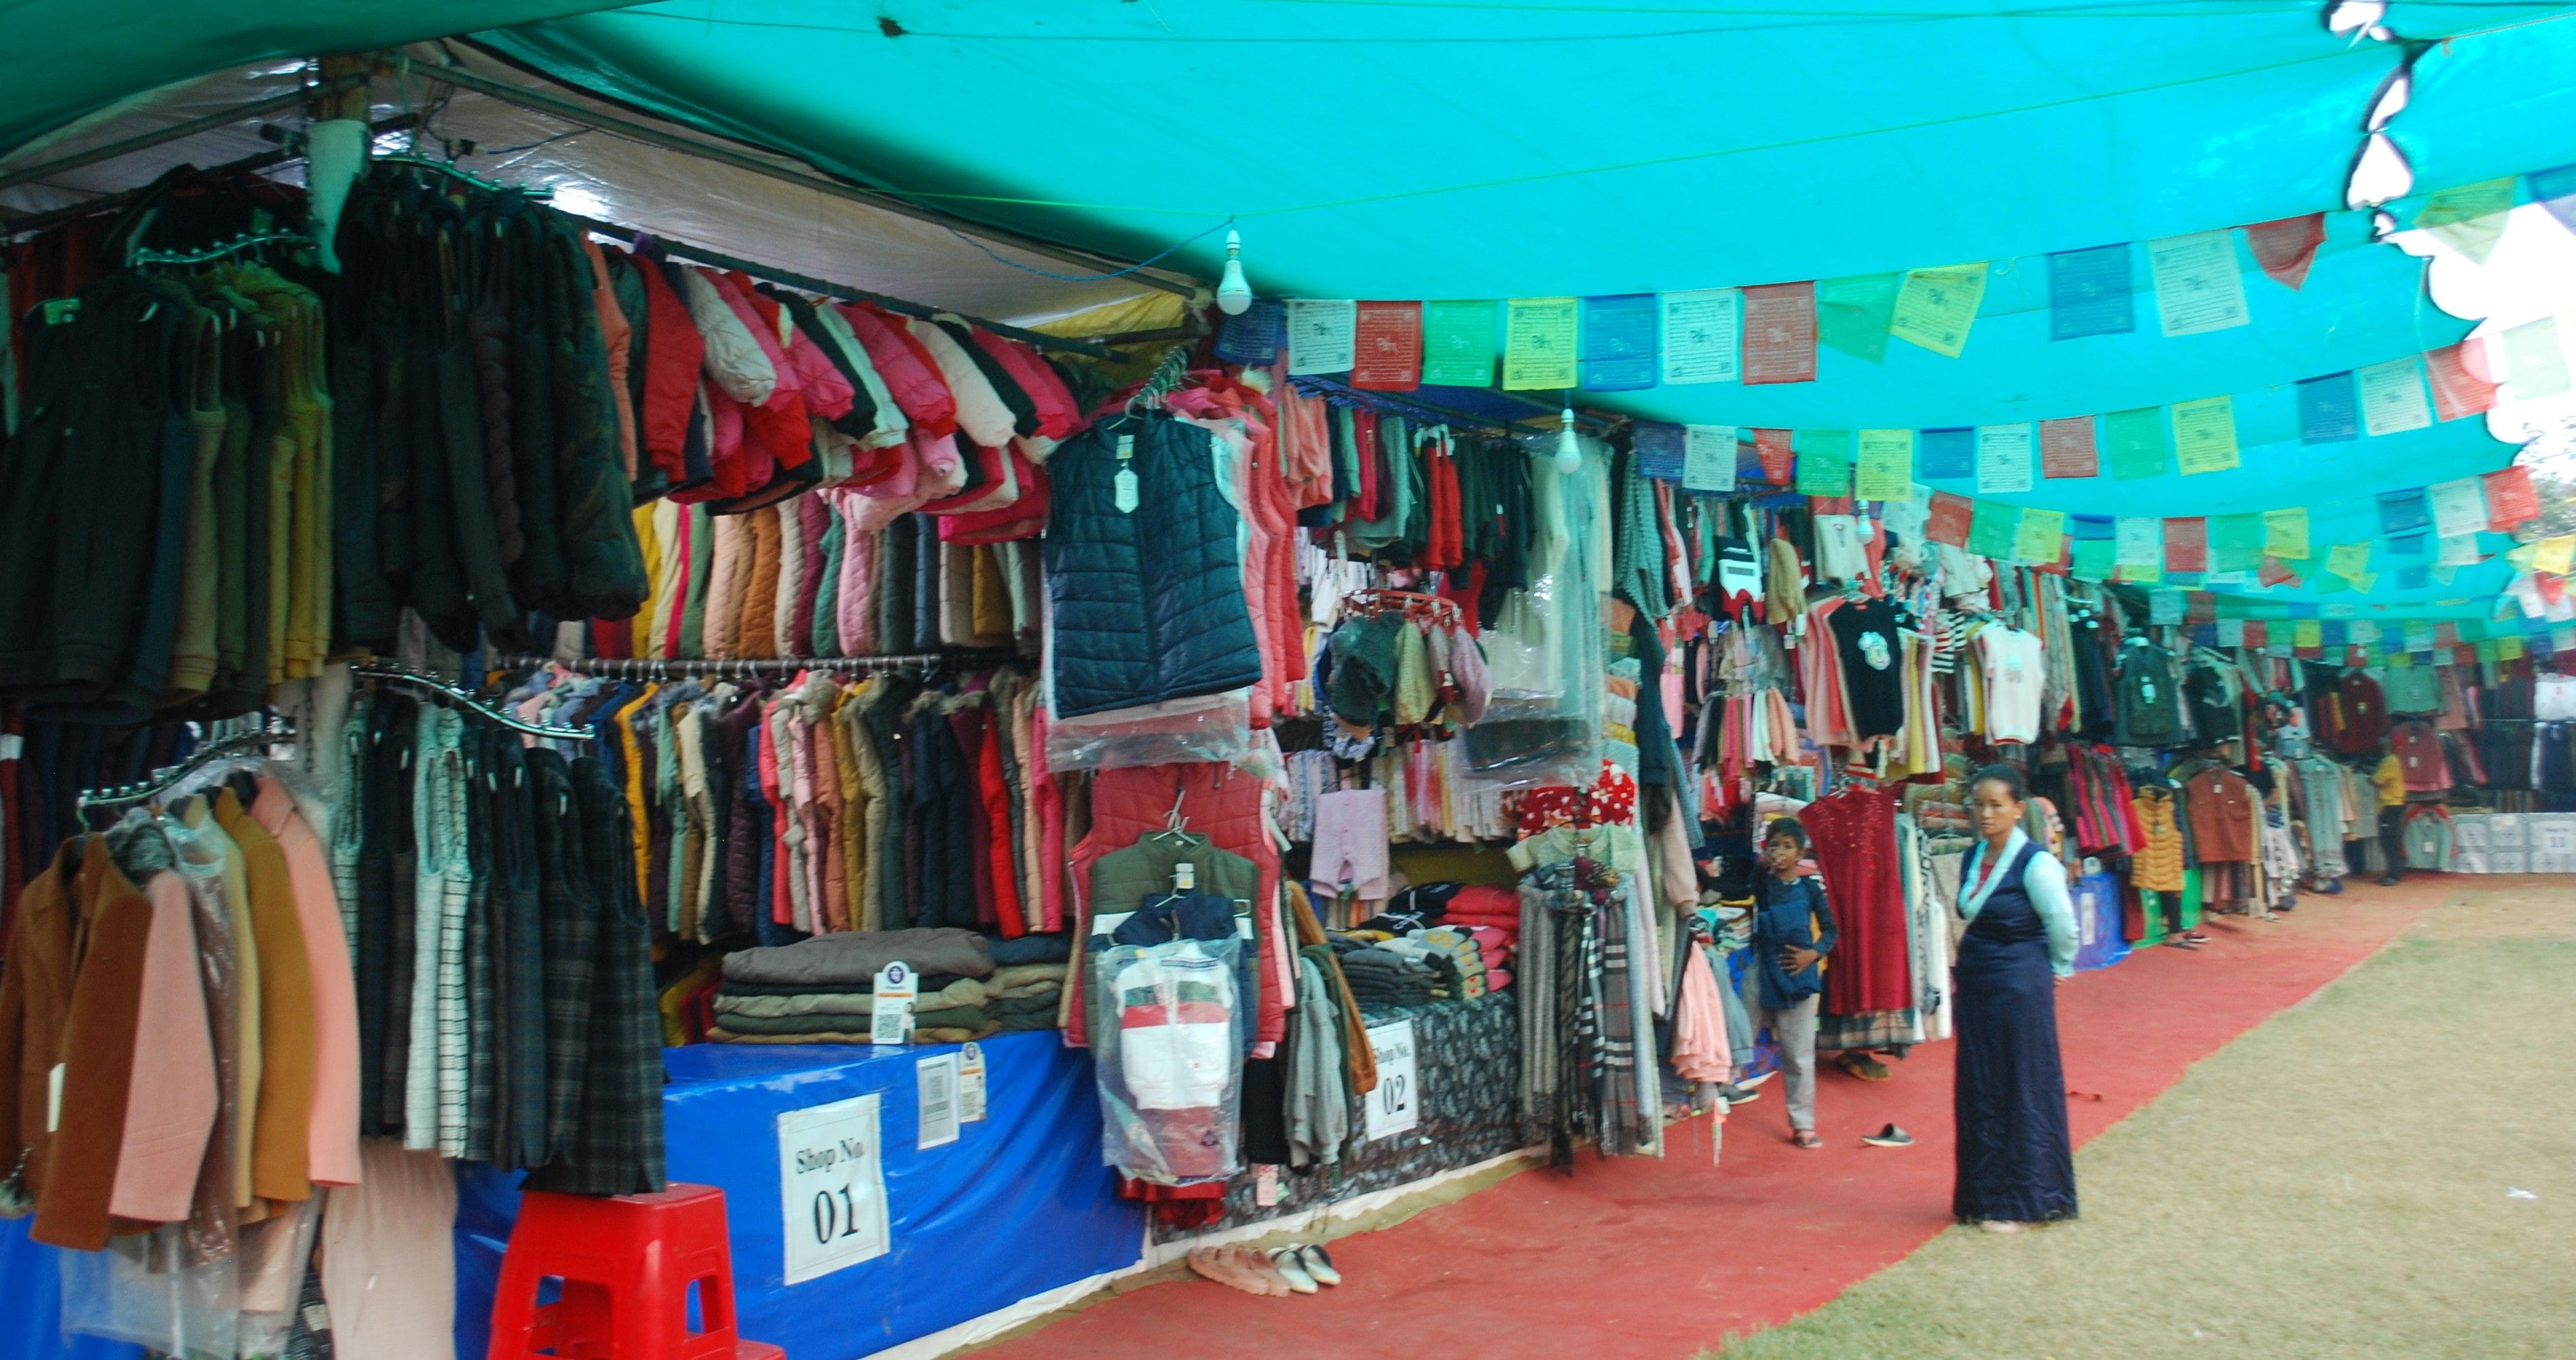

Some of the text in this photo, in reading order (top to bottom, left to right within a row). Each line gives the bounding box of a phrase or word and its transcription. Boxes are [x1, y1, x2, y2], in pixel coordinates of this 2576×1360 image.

[1383, 1074, 1406, 1115] 02
[796, 1148, 836, 1174] Shop
[814, 1183, 859, 1245] 01
